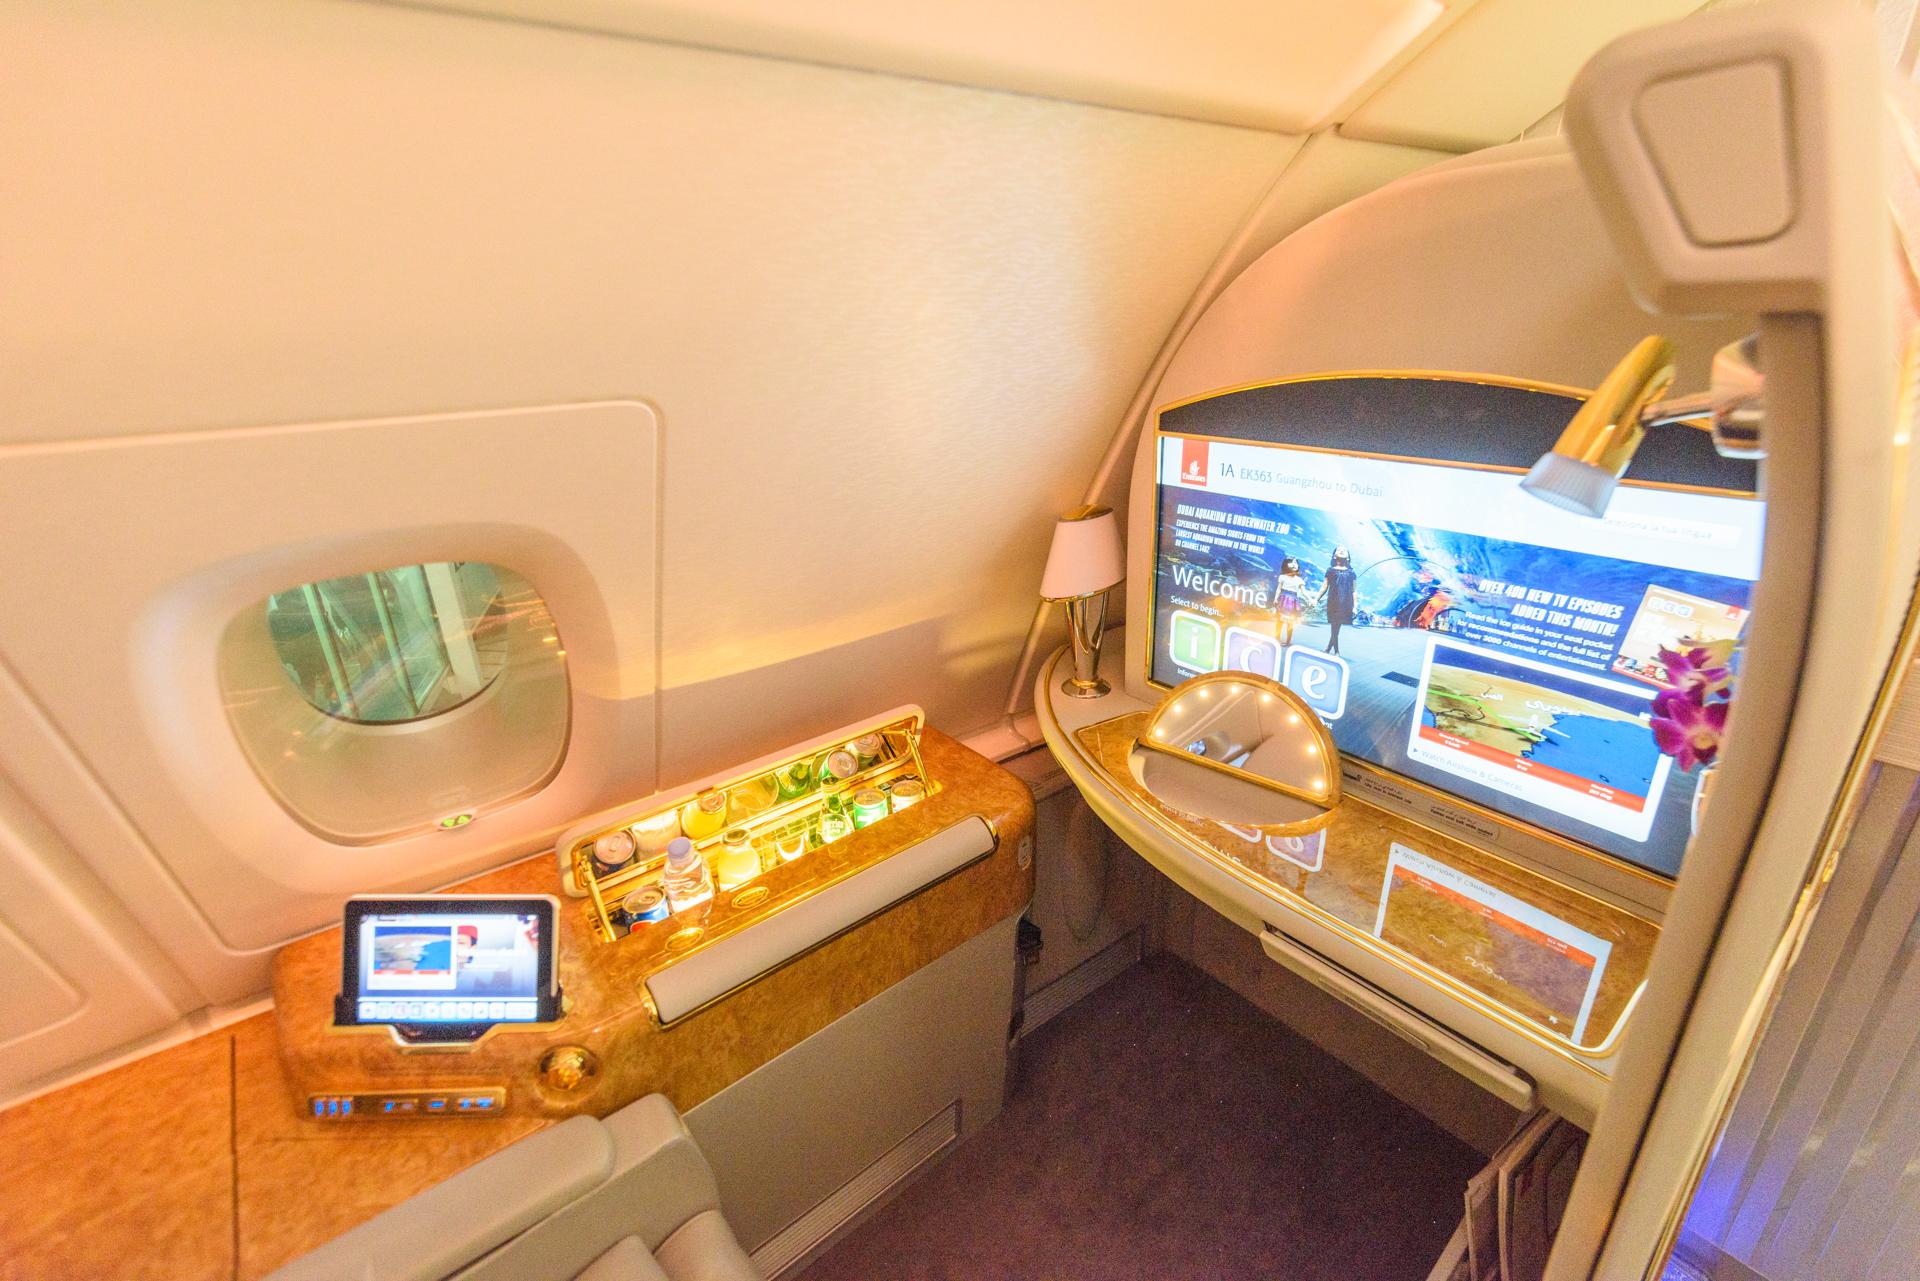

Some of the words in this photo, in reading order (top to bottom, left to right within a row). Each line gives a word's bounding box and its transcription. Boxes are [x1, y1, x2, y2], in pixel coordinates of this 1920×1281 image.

[1220, 462, 1235, 479] 1A
[1240, 467, 1272, 483] EK363
[1276, 473, 1332, 490] Guangzhou
[1336, 482, 1346, 492] to
[1350, 482, 1383, 497] Dubai
[1177, 503, 1195, 517] DUBAI
[1194, 507, 1227, 523] AQUARIUM
[1232, 514, 1276, 533] UNDERWATER
[1275, 522, 1290, 535] ZOO
[1170, 595, 1191, 608] Select
[1191, 602, 1199, 610] to
[1172, 564, 1268, 609] Welcome
[1478, 579, 1505, 595] OVER
[1504, 584, 1527, 600] 400
[1525, 588, 1554, 605] NEW
[1552, 593, 1570, 608] TV
[1566, 596, 1625, 620] EPISODES
[1465, 611, 1486, 622] Read
[1485, 616, 1499, 625] the
[1511, 623, 1535, 633] guide
[1534, 626, 1544, 635] in
[1543, 630, 1564, 639] your
[1563, 634, 1584, 644] seat
[1510, 603, 1547, 622] ADDED
[1546, 610, 1574, 627] THIS
[1571, 616, 1620, 637] MONTH!
[1465, 631, 1482, 640] over
[1502, 640, 1537, 654] channels
[1537, 648, 1549, 656] of
[1467, 622, 1540, 645] recommendations
[1540, 639, 1557, 648] and
[1556, 642, 1572, 652] the
[1571, 646, 1587, 655] full
[1585, 649, 1601, 659] list
[1301, 662, 1328, 701] e
